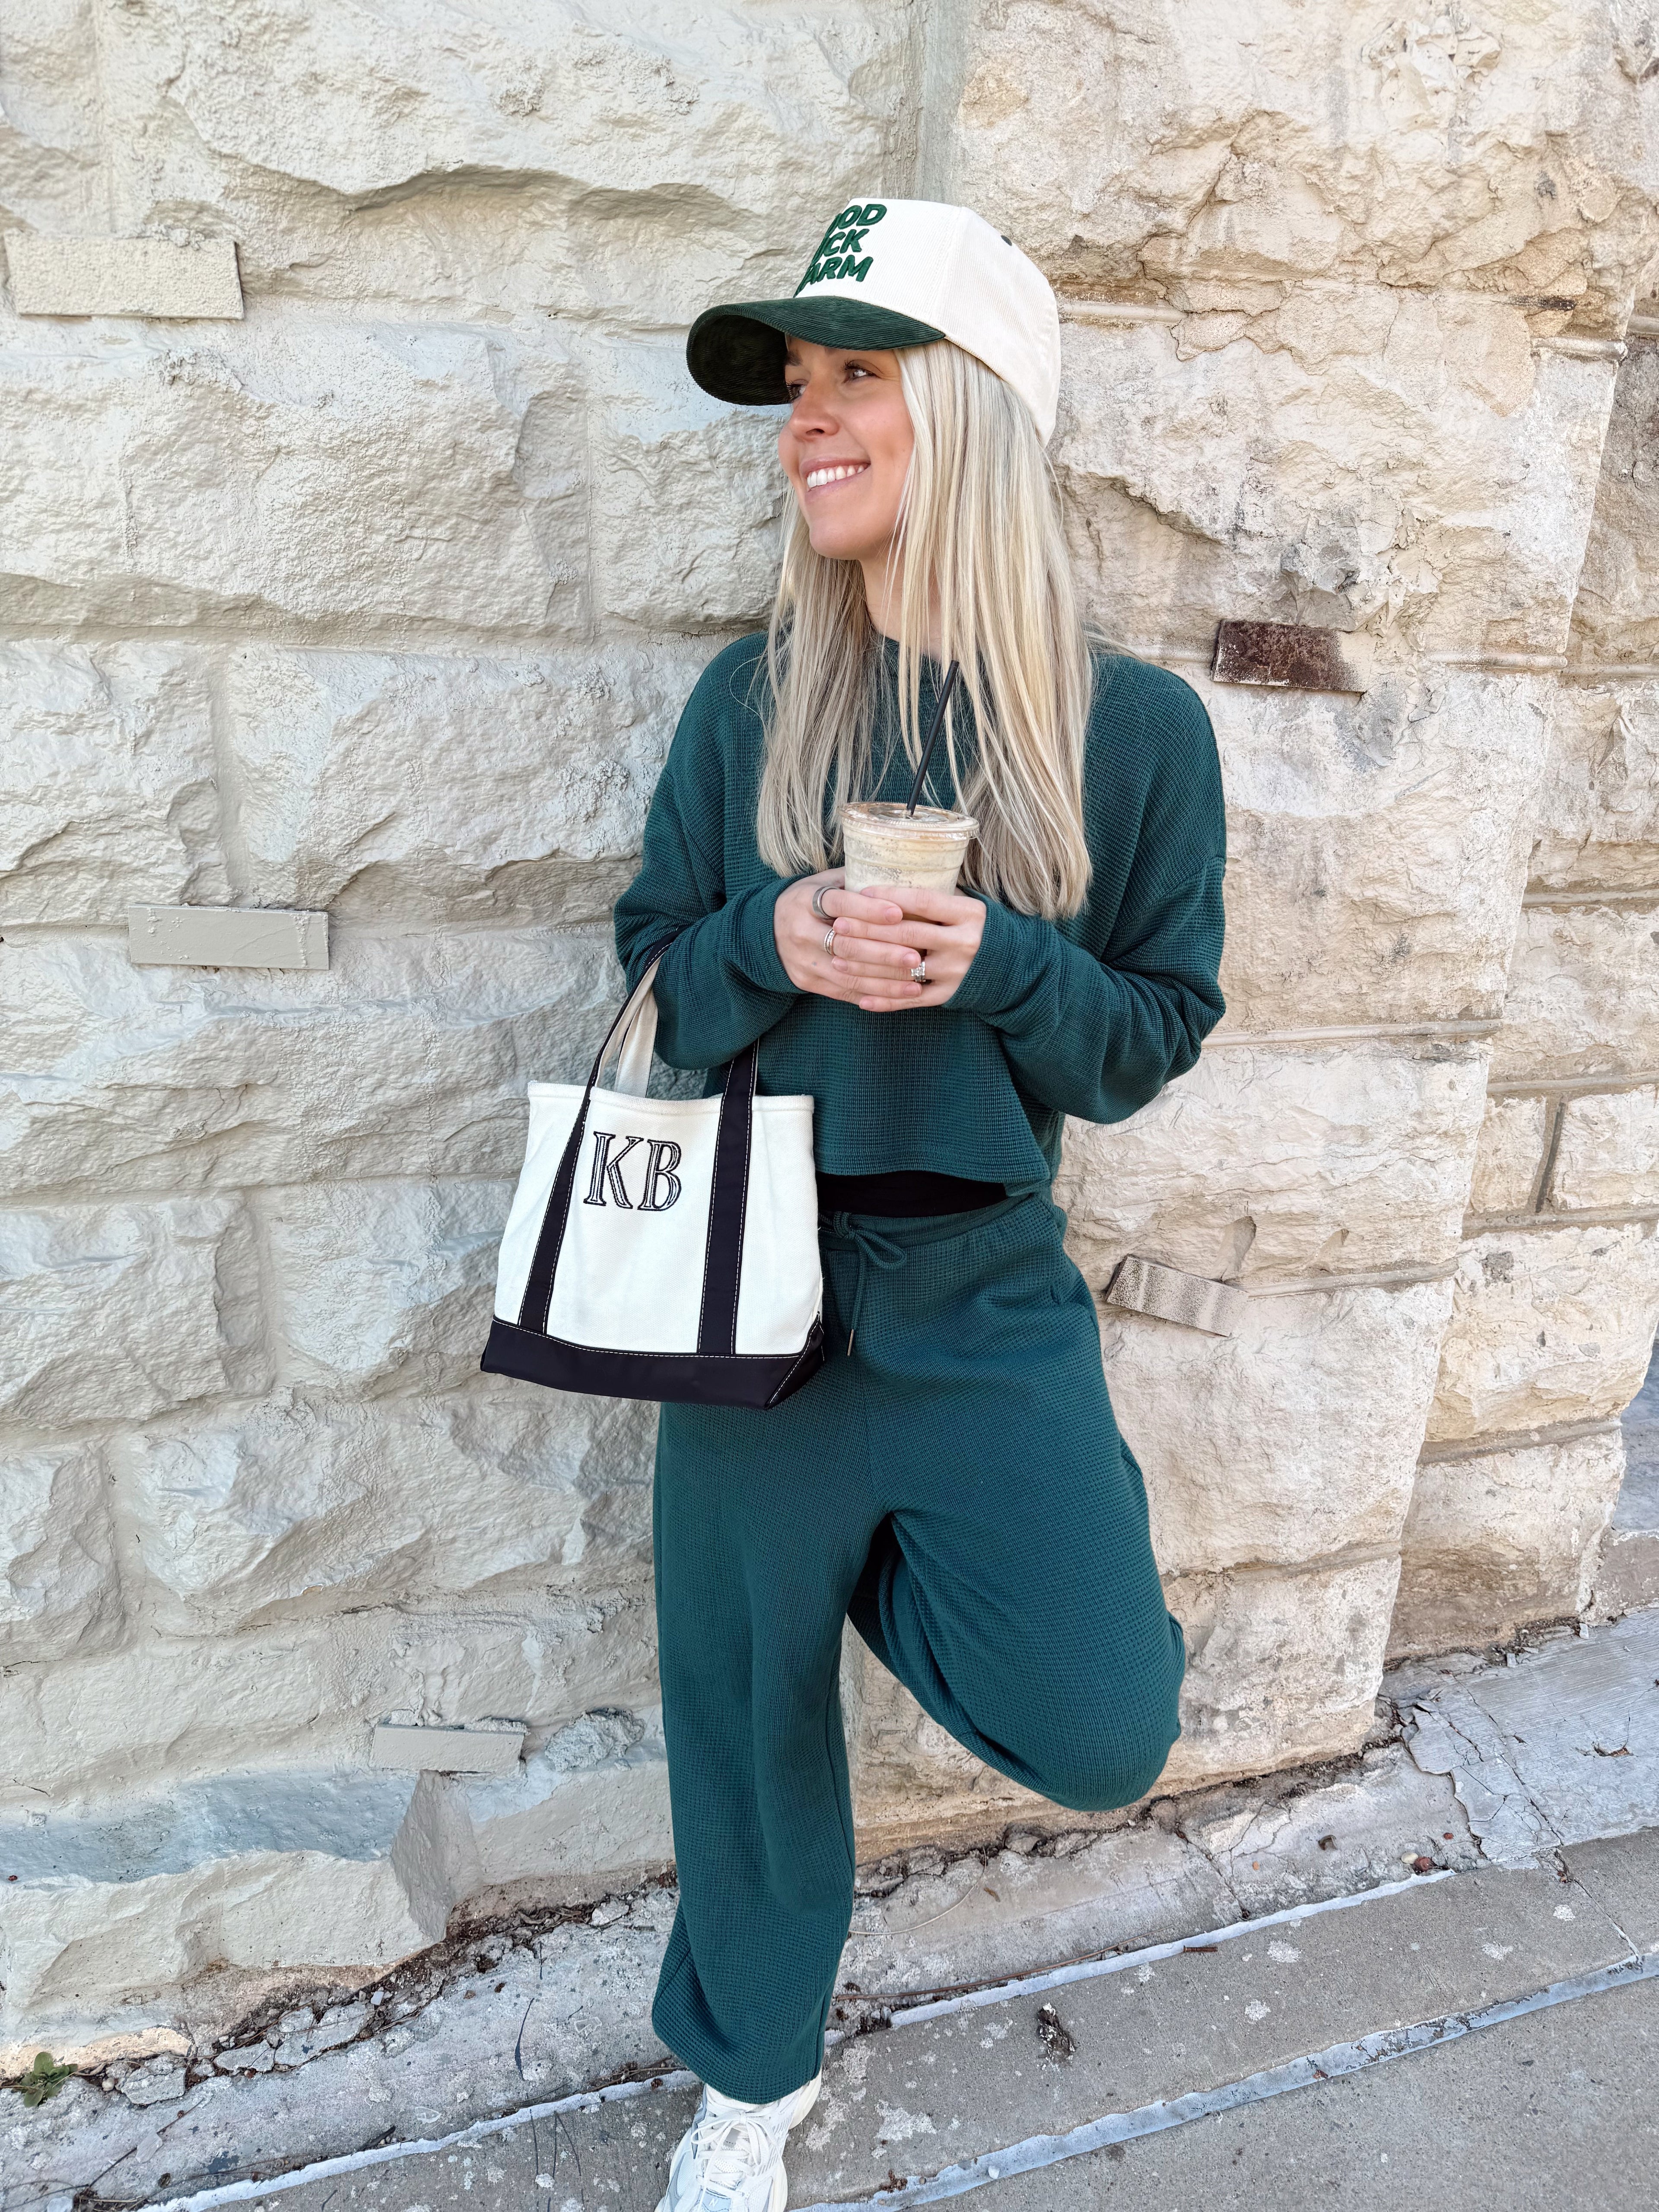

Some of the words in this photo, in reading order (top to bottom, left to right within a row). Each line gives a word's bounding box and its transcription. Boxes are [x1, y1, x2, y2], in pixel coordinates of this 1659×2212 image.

[825, 203, 887, 236] OD
[812, 228, 870, 265] CK
[793, 254, 874, 298] ARM
[583, 1131, 682, 1211] KB
